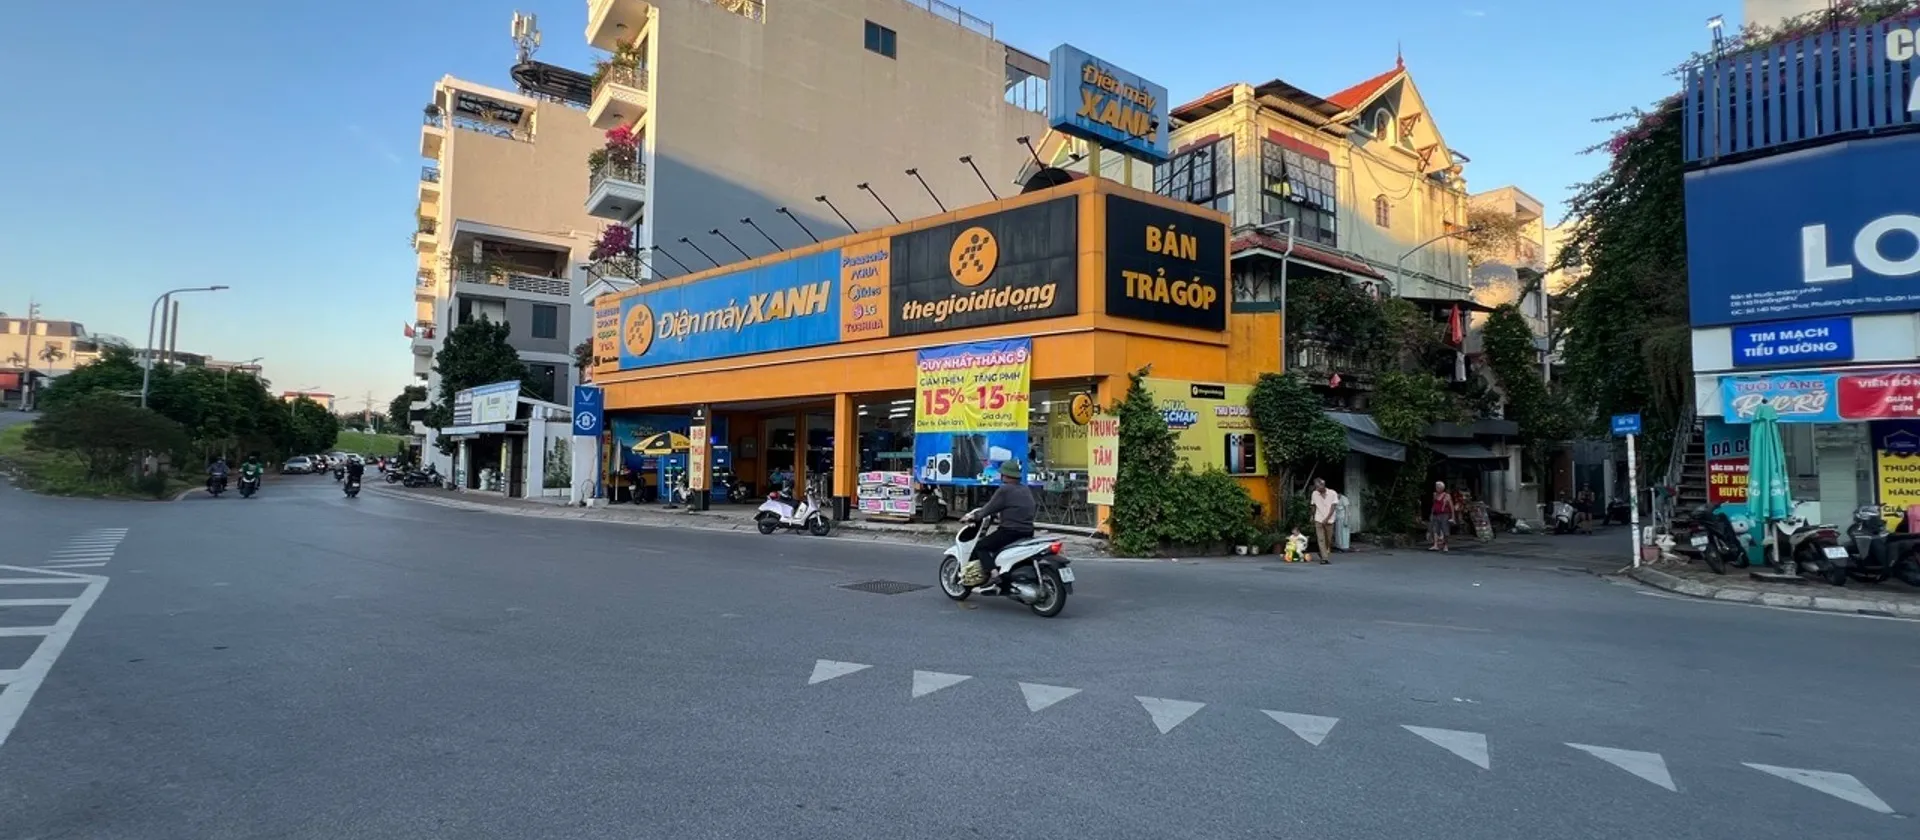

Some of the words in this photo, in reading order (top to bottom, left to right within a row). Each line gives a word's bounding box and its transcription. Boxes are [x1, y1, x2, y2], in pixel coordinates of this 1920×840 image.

[1886, 27, 1920, 61] C
[1145, 223, 1197, 261] BÁN
[1122, 266, 1170, 304] TRẢ
[1170, 275, 1217, 310] GÓP
[657, 308, 700, 342] Điện
[701, 298, 749, 333] máy
[742, 281, 832, 326] XANH
[865, 304, 877, 316] LG
[902, 283, 1057, 323] thegioididong
[844, 319, 884, 333] TOSHIBA
[1750, 331, 1776, 343] TIM
[1779, 326, 1829, 343] MẠCH
[1016, 347, 1027, 363] 9
[1743, 342, 1774, 357] TIỂU
[1777, 340, 1839, 356] ĐƯỜNG
[1858, 378, 1889, 389] VIÊN
[922, 386, 965, 416] 15%
[1089, 419, 1116, 438] TRUNG
[1093, 446, 1112, 466] TÂM
[1711, 472, 1728, 485] SỐT
